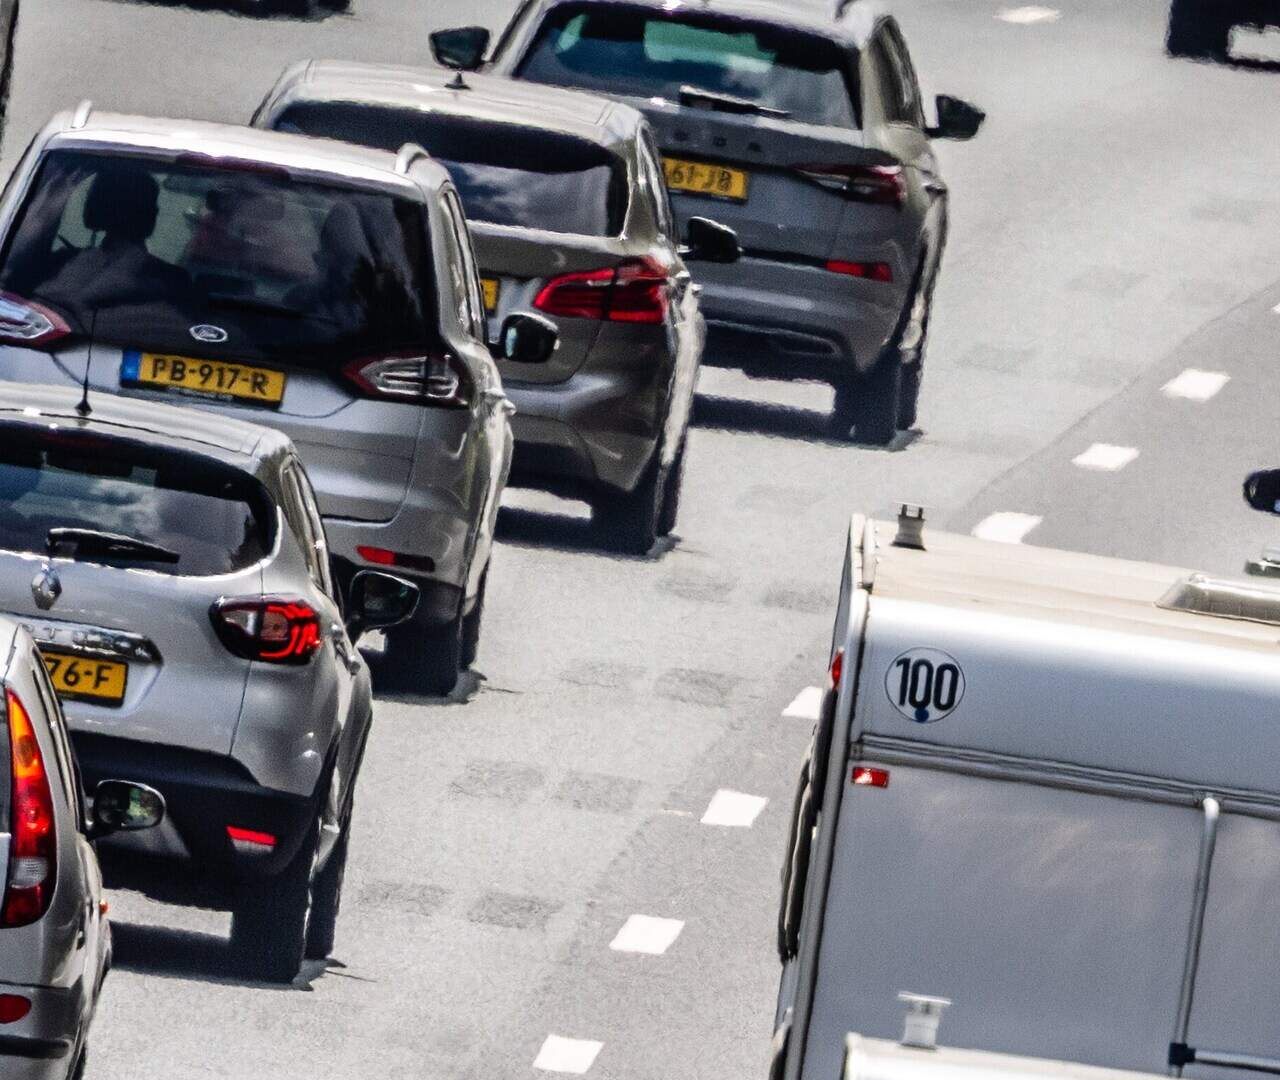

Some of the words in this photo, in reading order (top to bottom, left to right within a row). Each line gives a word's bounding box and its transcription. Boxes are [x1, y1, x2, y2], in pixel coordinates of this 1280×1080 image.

[151, 357, 270, 397] PB-917-R
[43, 655, 113, 690] 76-F
[895, 656, 960, 712] 100
